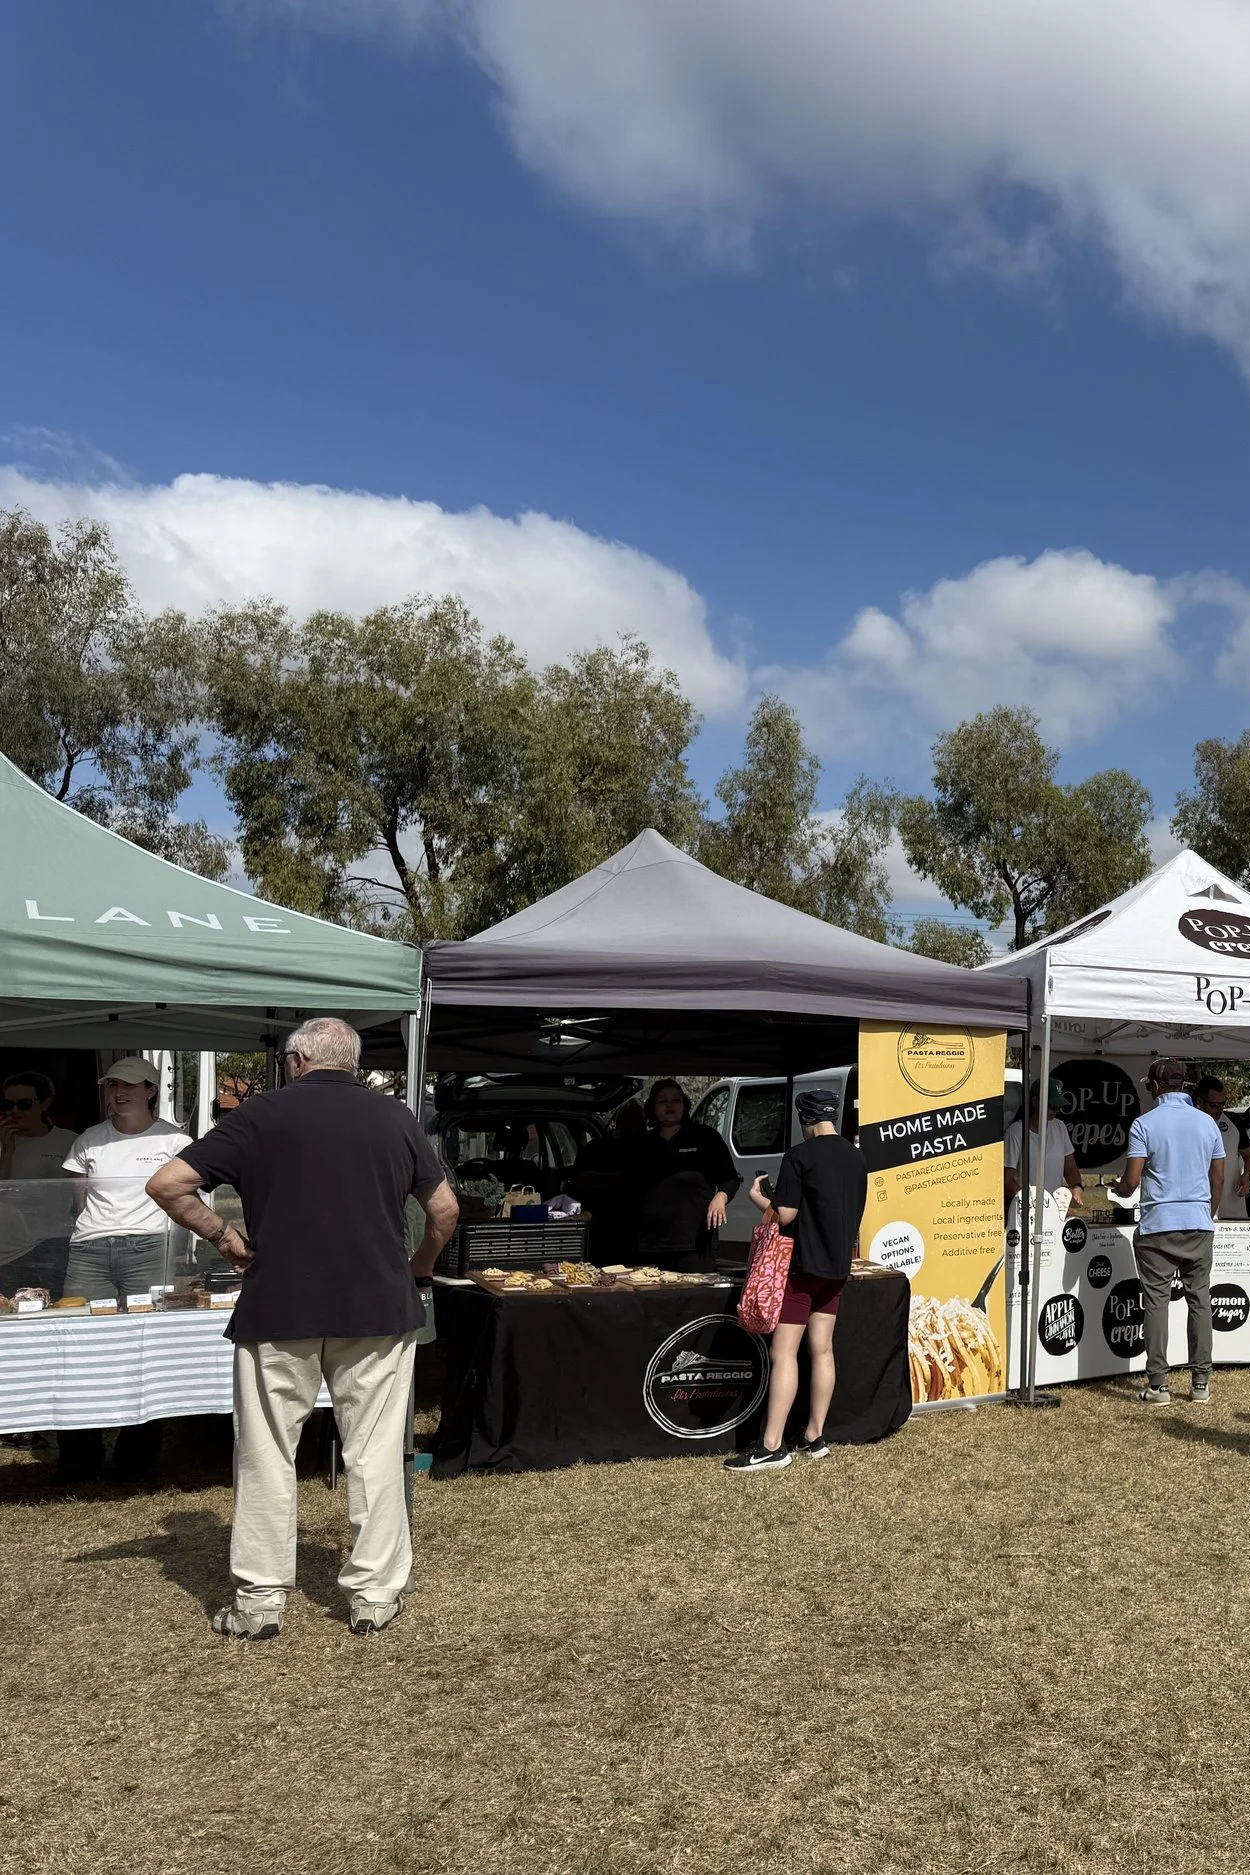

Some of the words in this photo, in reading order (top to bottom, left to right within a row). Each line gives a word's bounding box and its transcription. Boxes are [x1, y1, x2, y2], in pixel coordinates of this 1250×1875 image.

[25, 900, 291, 933] LANE
[1060, 1081, 1135, 1117] OP-UP
[879, 1116, 933, 1142] HOME
[936, 1104, 987, 1129] MADE
[910, 1133, 967, 1159] PASTA
[895, 1153, 983, 1182] PASTAREGGIO.COM.AU
[903, 1167, 980, 1195] @PASTAREGGIOVIC
[941, 1199, 971, 1209] Locally
[973, 1197, 996, 1207] made
[932, 1215, 955, 1225] Local
[957, 1213, 1003, 1226] ingredients
[882, 1235, 910, 1248] VEGAN
[933, 1230, 986, 1241] Preservative
[987, 1228, 1003, 1238] free
[880, 1246, 915, 1260] OPTIONS
[942, 1247, 977, 1258] Additive
[979, 1246, 996, 1256] free
[886, 1256, 922, 1271] AILABLE!
[1088, 1268, 1111, 1278] CHEESE
[1110, 1293, 1145, 1320] POP-U
[1210, 1297, 1246, 1306] emon
[1045, 1298, 1074, 1326] APPLE
[1111, 1323, 1145, 1347] crepe
[661, 1373, 704, 1384] PASTA
[706, 1372, 753, 1380] REGGIO
